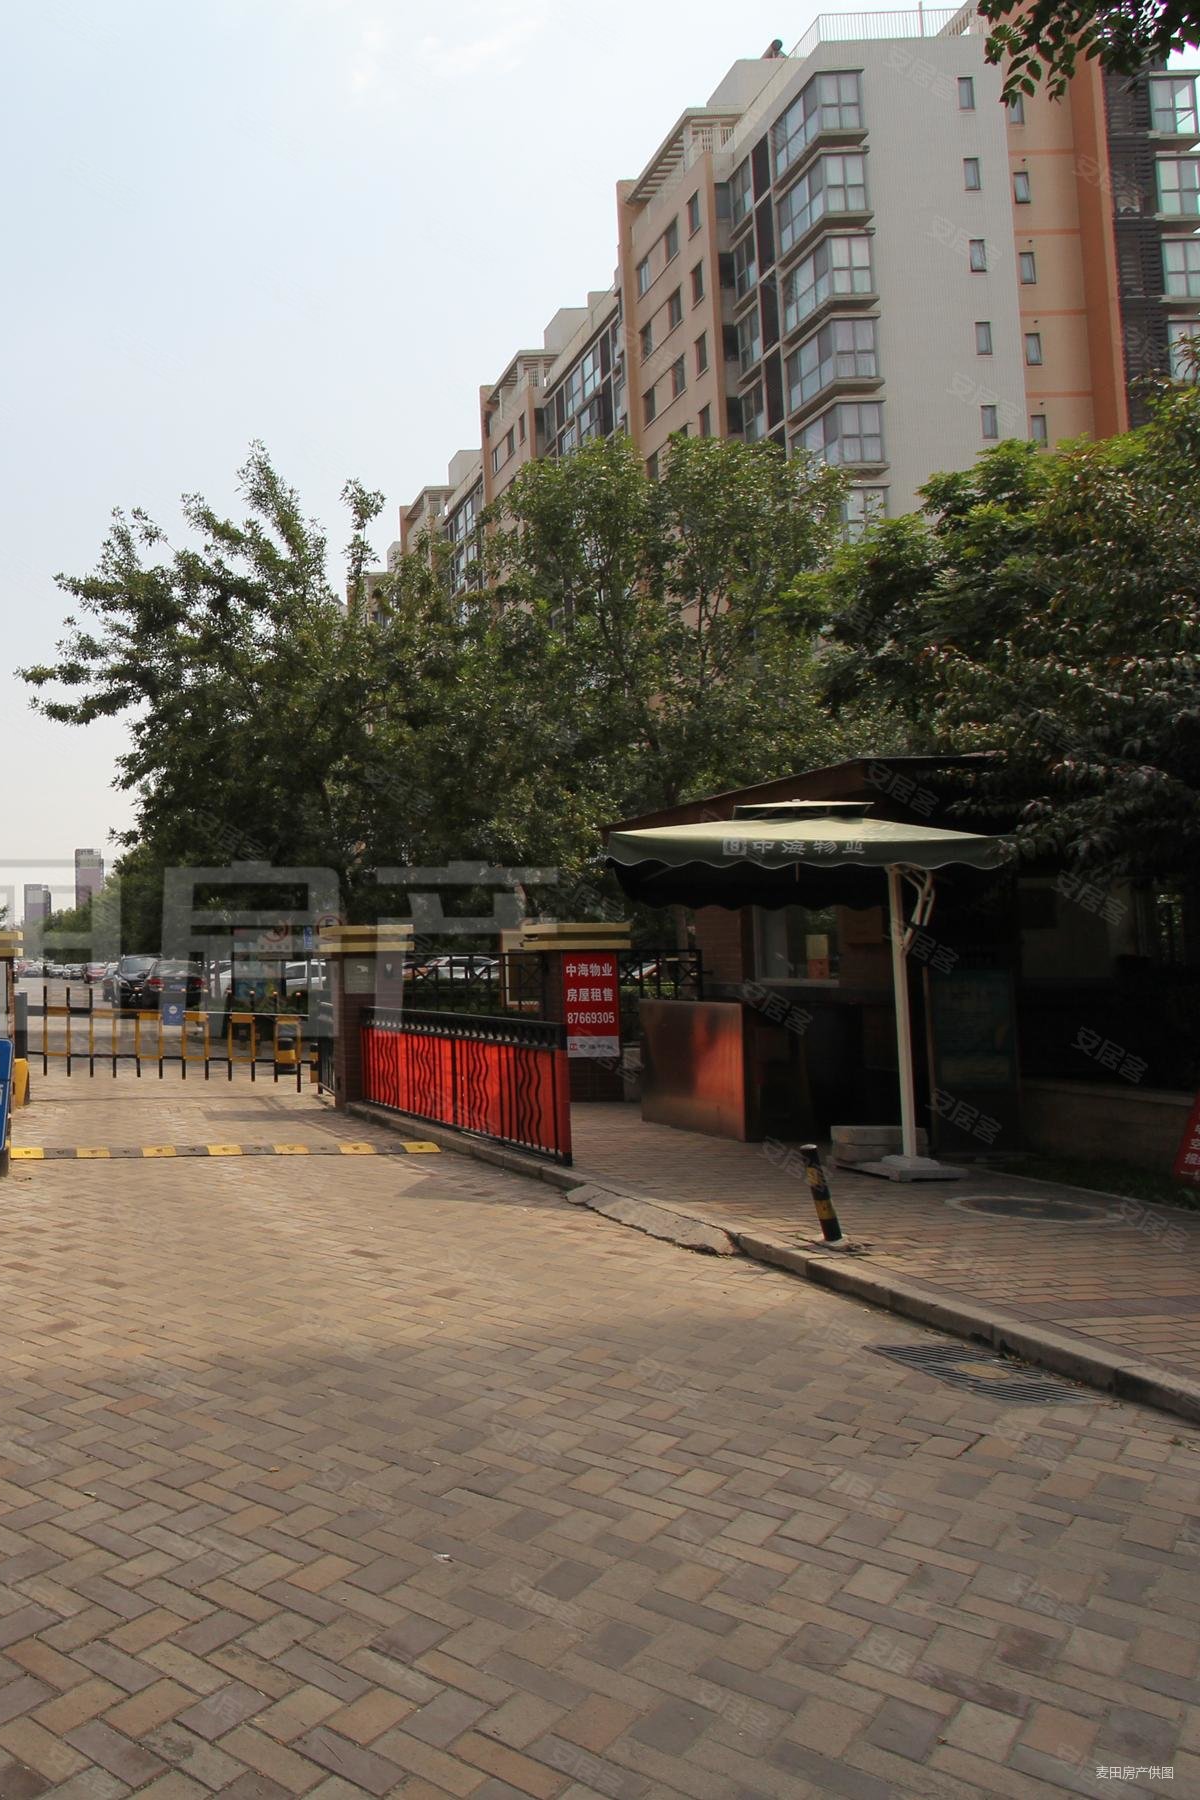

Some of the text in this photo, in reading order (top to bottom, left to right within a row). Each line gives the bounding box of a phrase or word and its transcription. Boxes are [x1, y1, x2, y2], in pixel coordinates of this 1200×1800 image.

[752, 839, 866, 855] 中海物业
[565, 963, 613, 977] 中海物业
[566, 988, 614, 1002] 房屋租售
[567, 1012, 615, 1024] 87669305
